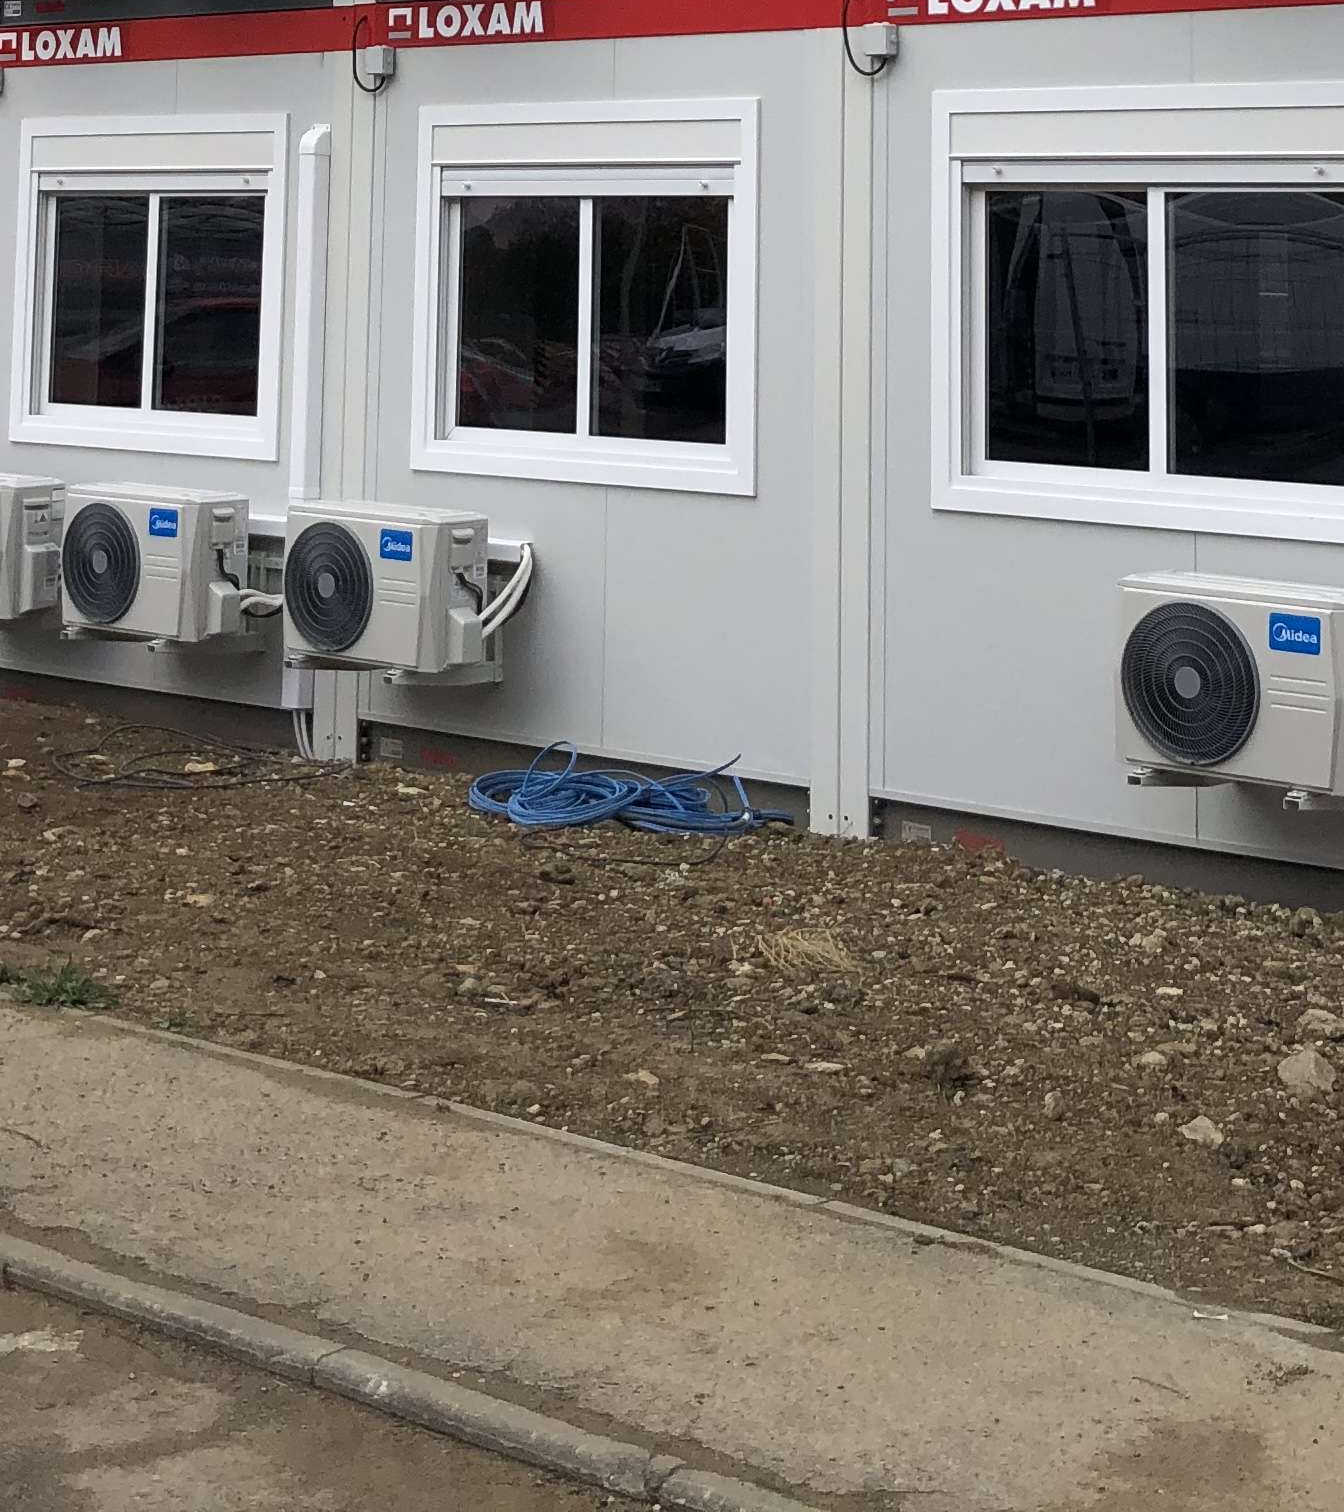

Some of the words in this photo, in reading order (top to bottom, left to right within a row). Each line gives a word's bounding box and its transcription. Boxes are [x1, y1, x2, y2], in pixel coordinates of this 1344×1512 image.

[418, 0, 544, 39] LOXAM
[21, 26, 122, 61] LOXAM
[1272, 622, 1318, 644] Midea
